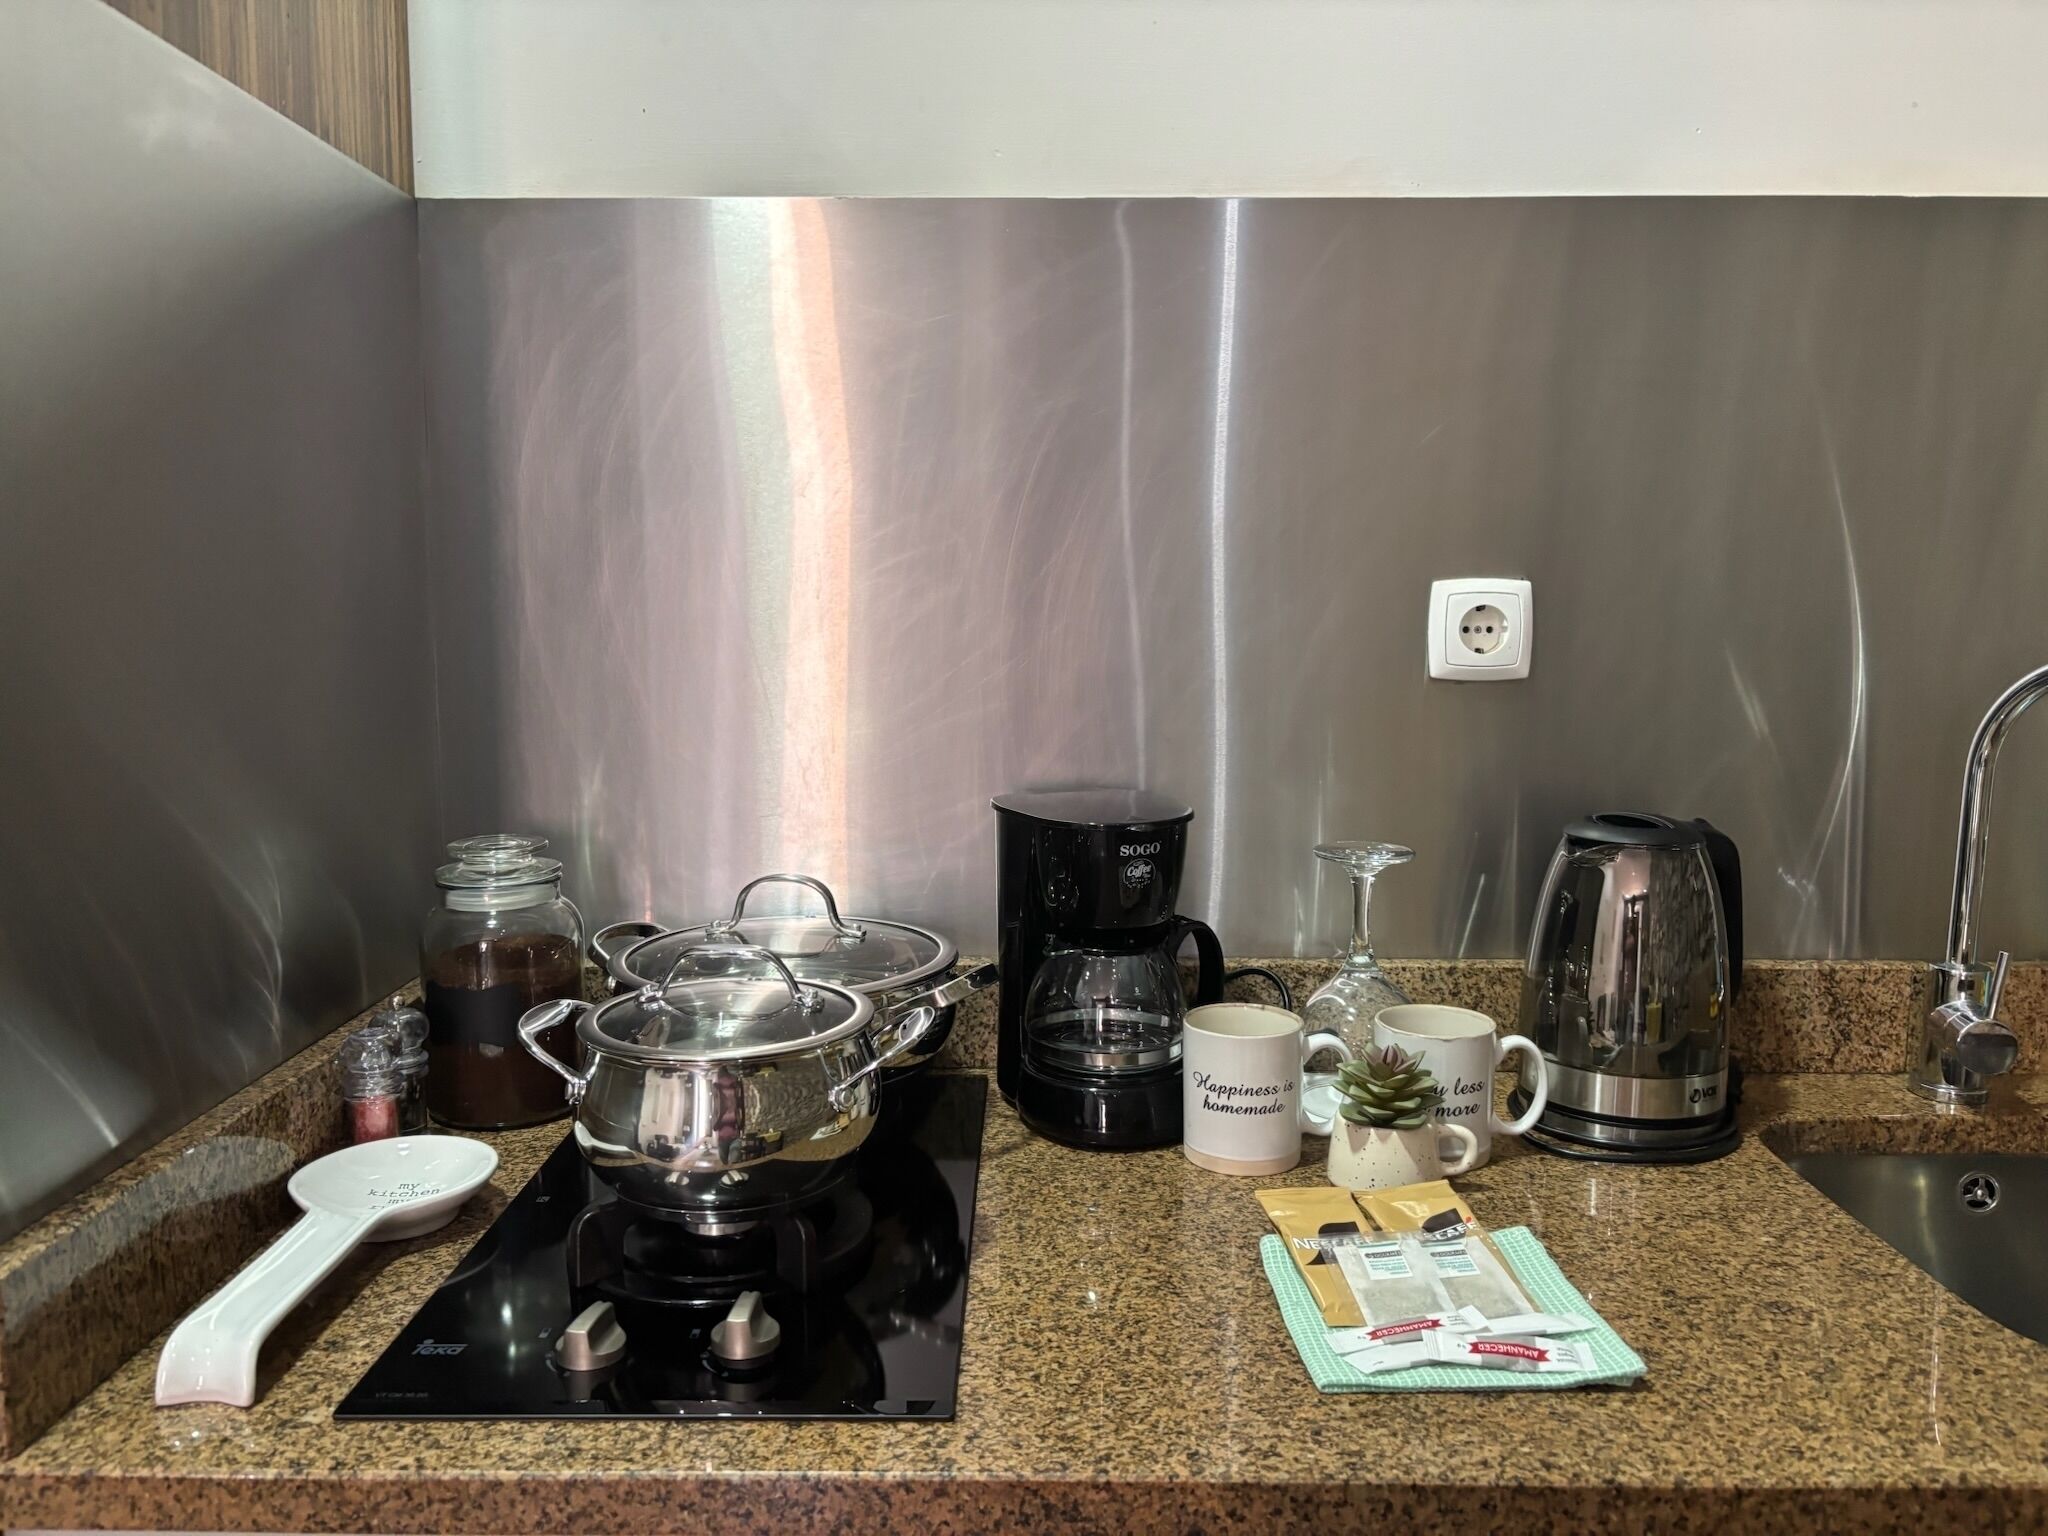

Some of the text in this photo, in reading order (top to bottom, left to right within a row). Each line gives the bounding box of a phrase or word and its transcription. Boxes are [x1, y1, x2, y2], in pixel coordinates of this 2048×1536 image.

[1119, 842, 1160, 856] SOGO
[1127, 864, 1152, 877] Coffee
[1193, 1071, 1296, 1101] Happiness is
[1454, 1076, 1486, 1096] less
[1203, 1094, 1287, 1115] homemade
[1435, 1103, 1481, 1117] more
[368, 1188, 441, 1197] kitchen
[1375, 1319, 1433, 1337] AMANHECER
[1478, 1342, 1539, 1358] AMANHECER
